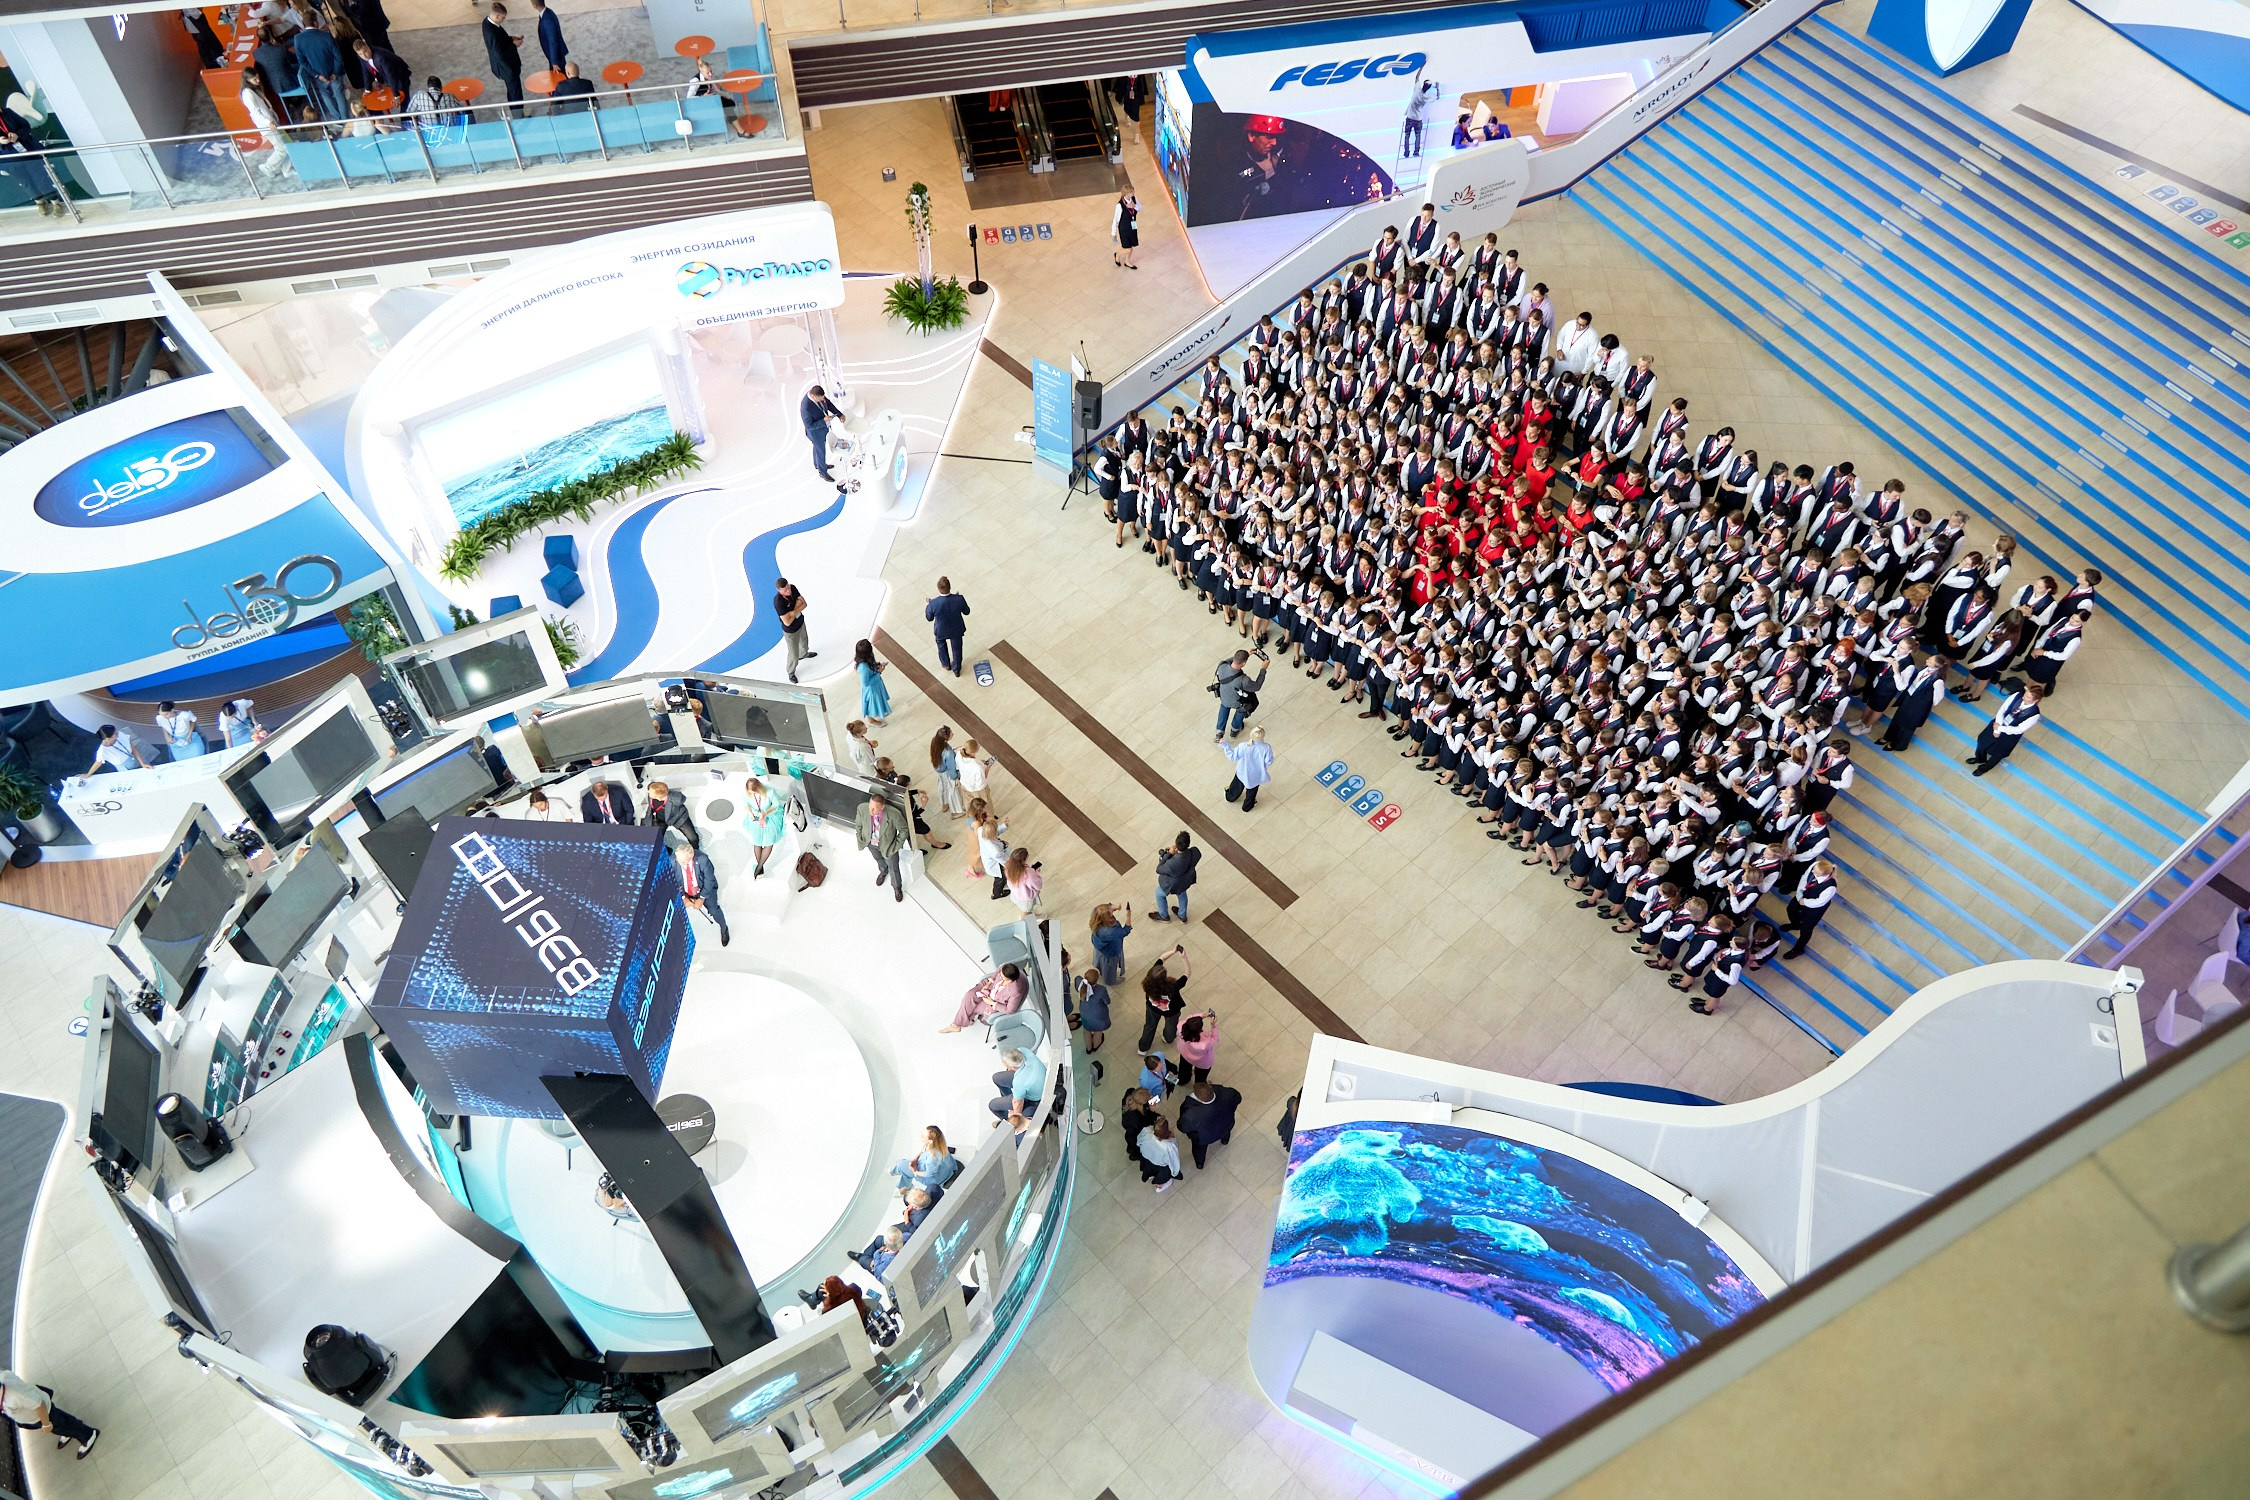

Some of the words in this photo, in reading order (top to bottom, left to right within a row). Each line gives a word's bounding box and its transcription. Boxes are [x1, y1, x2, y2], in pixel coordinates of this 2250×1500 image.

[1269, 52, 1428, 92] FESCO
[1632, 70, 1695, 120] AEROFLOT
[630, 247, 682, 264] ЭНЕРГИЯ
[684, 235, 756, 253] СОЗИДАНИЯ
[724, 258, 832, 287] РусГидро
[480, 304, 522, 330] ЭНЕРГИЯ
[523, 284, 574, 309] ДАЛЬНЕГО
[575, 272, 624, 289] ВОСТОКА
[696, 308, 763, 327] ОБЪЕДИНЯЯ
[765, 301, 818, 315] ЭНЕРГИЮ
[1149, 325, 1216, 380] АЭРОФЛОТ
[186, 645, 221, 661] ГРУППА
[221, 628, 269, 651] КОМПАНИЙ
[1322, 772, 1333, 781] B
[1340, 787, 1352, 796] C
[1357, 801, 1369, 810] D
[1375, 816, 1387, 825] S
